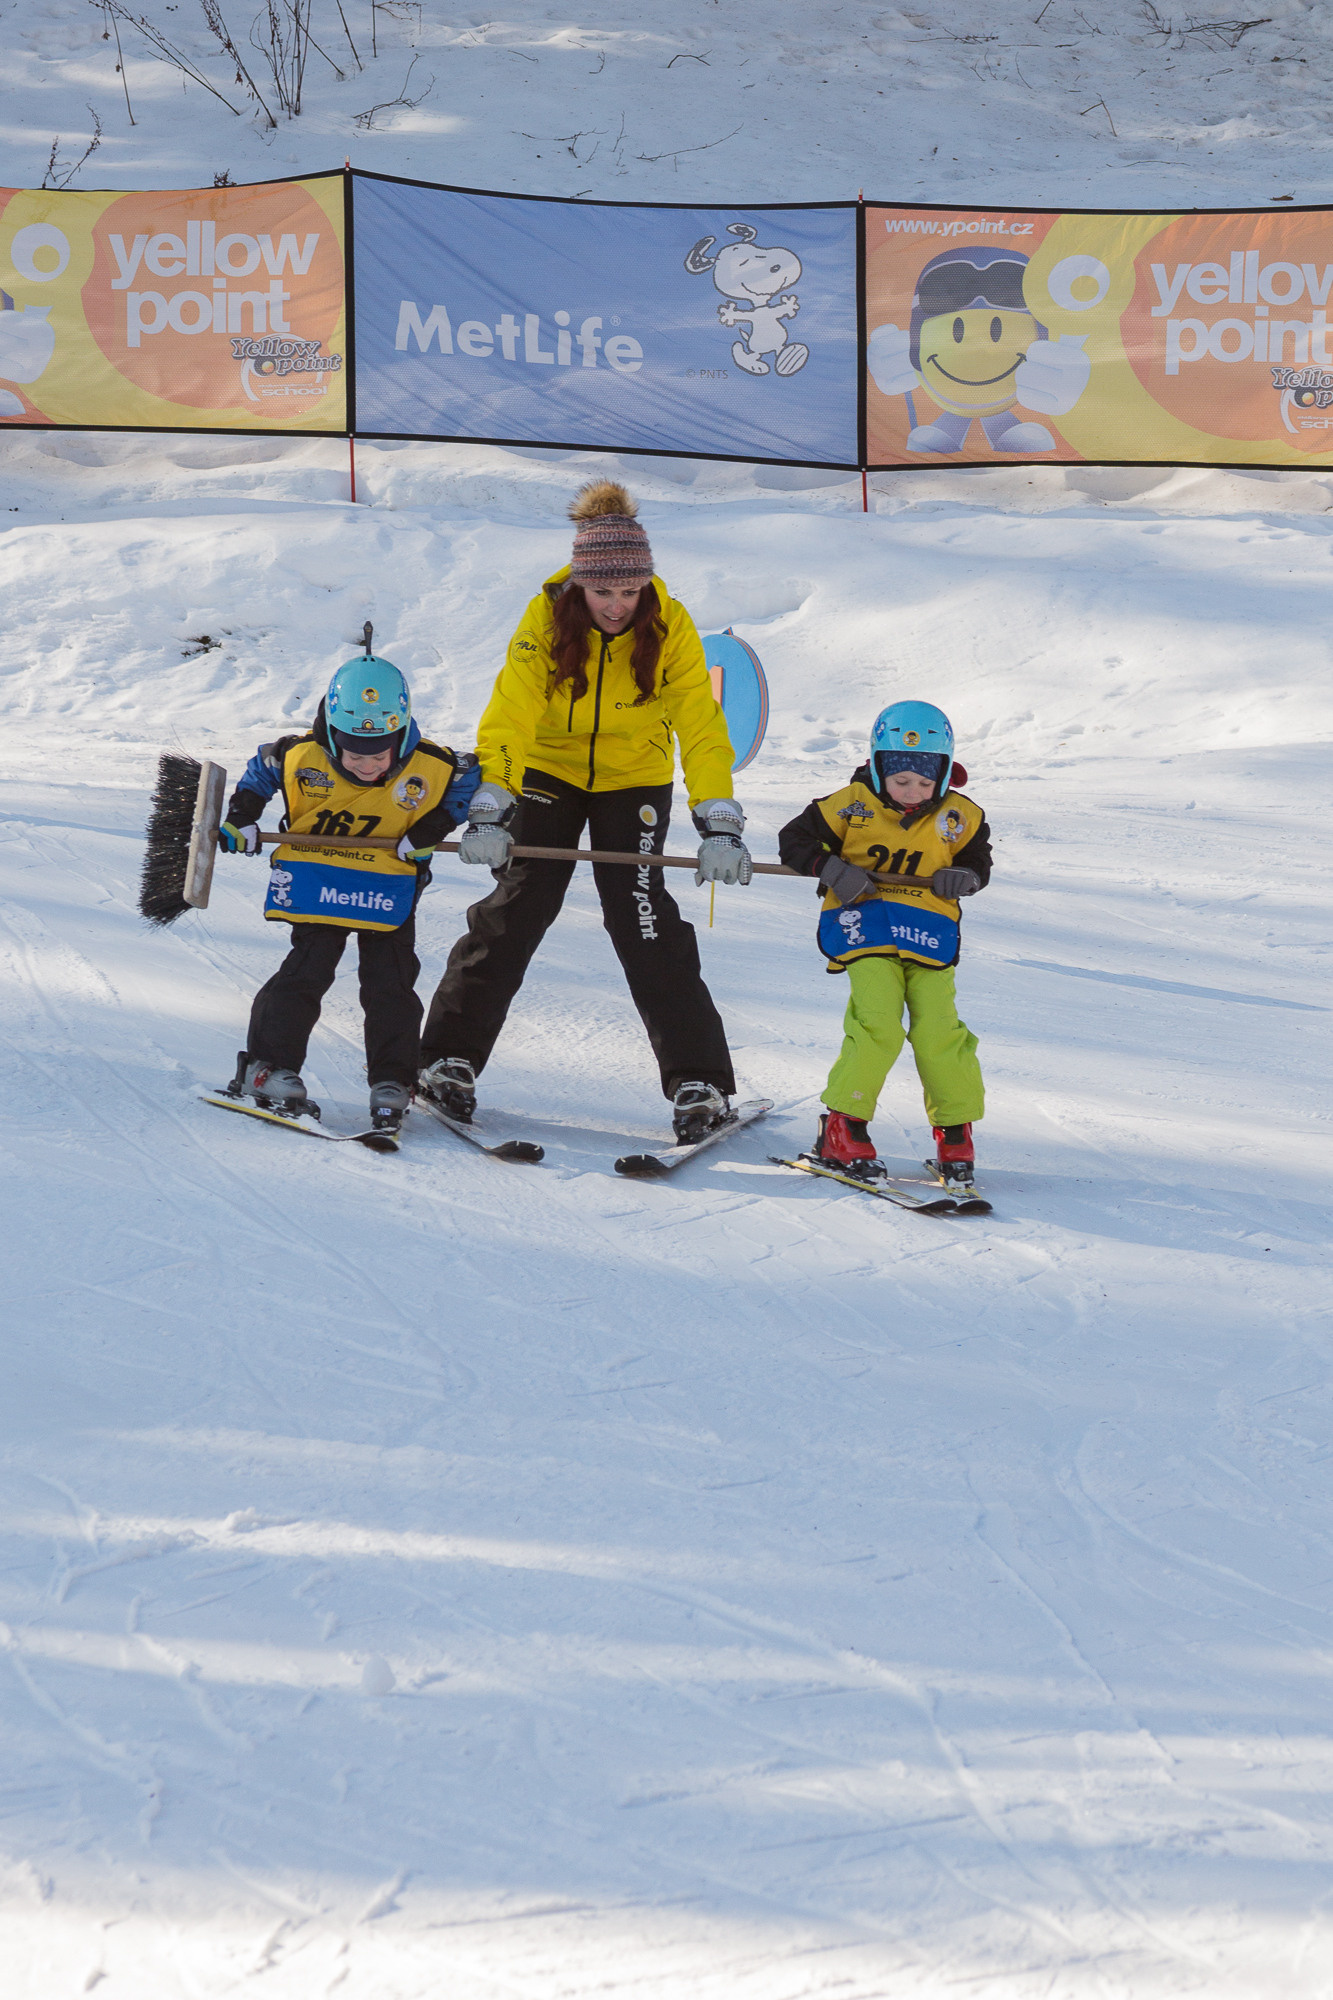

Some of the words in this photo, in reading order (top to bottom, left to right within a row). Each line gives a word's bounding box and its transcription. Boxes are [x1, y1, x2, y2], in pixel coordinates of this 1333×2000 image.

[885, 218, 1035, 237] www.ypoint.cz
[108, 220, 320, 290] yellow
[126, 277, 291, 348] point
[230, 336, 323, 360] Yellow
[1164, 305, 1333, 376] point
[275, 353, 343, 377] point
[700, 369, 729, 380] PNTS
[261, 385, 328, 397] school
[1270, 367, 1333, 391] Yello
[310, 809, 383, 838] 167
[867, 844, 924, 877] 211
[318, 886, 395, 912] MetLife
[632, 891, 659, 940] point
[890, 925, 940, 950] etLife
